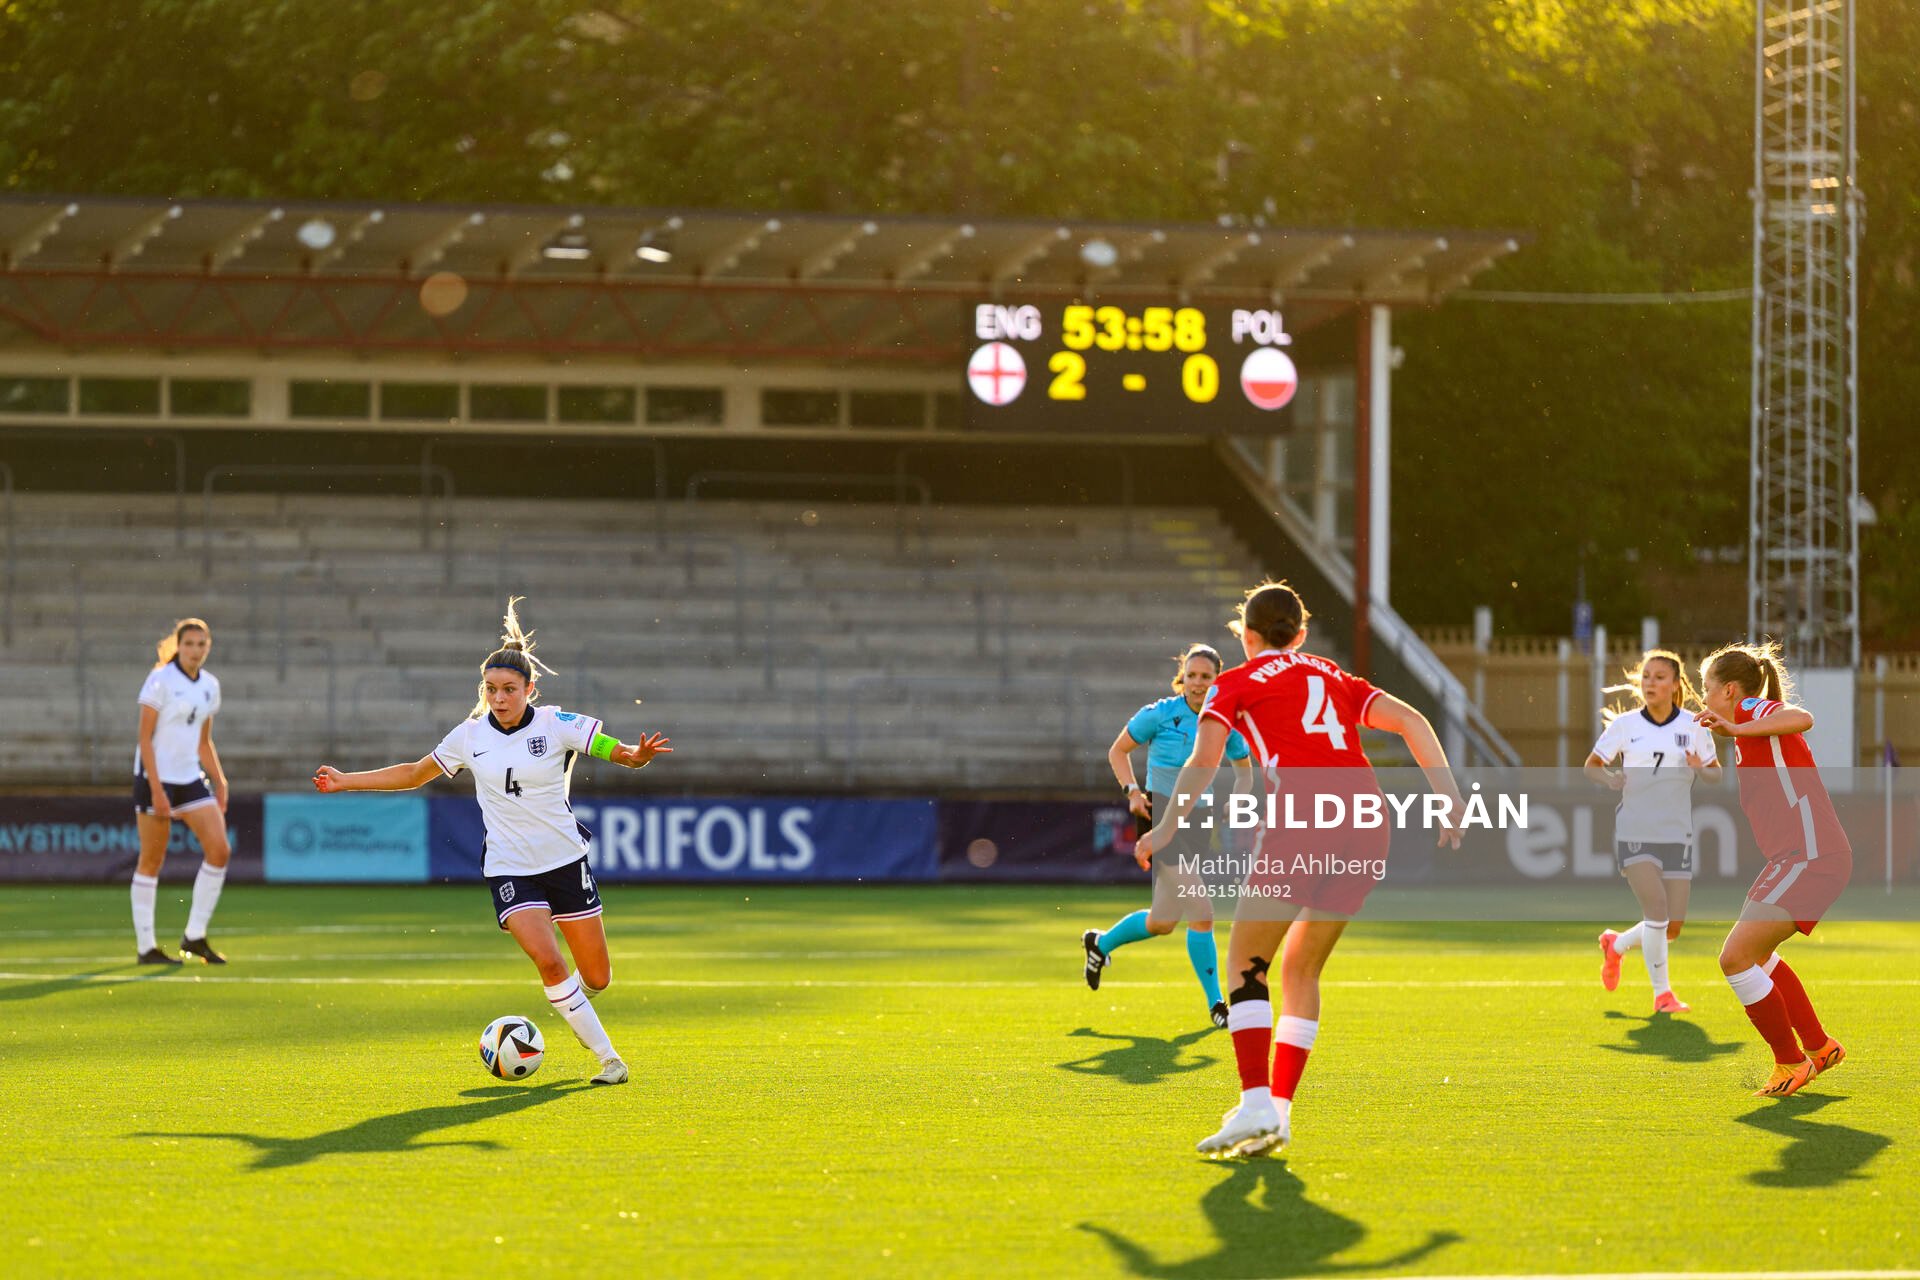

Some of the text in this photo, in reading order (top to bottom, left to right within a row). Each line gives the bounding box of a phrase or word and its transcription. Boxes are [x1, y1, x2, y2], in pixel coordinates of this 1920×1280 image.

[976, 304, 1042, 340] ENG
[1062, 305, 1207, 352] 53:58
[1232, 309, 1292, 345] POL
[1048, 351, 1087, 400] 2
[1182, 353, 1220, 403] 0
[1301, 675, 1348, 750] 4
[1653, 751, 1665, 775] 7
[505, 767, 522, 797] 4
[580, 861, 594, 892] 4
